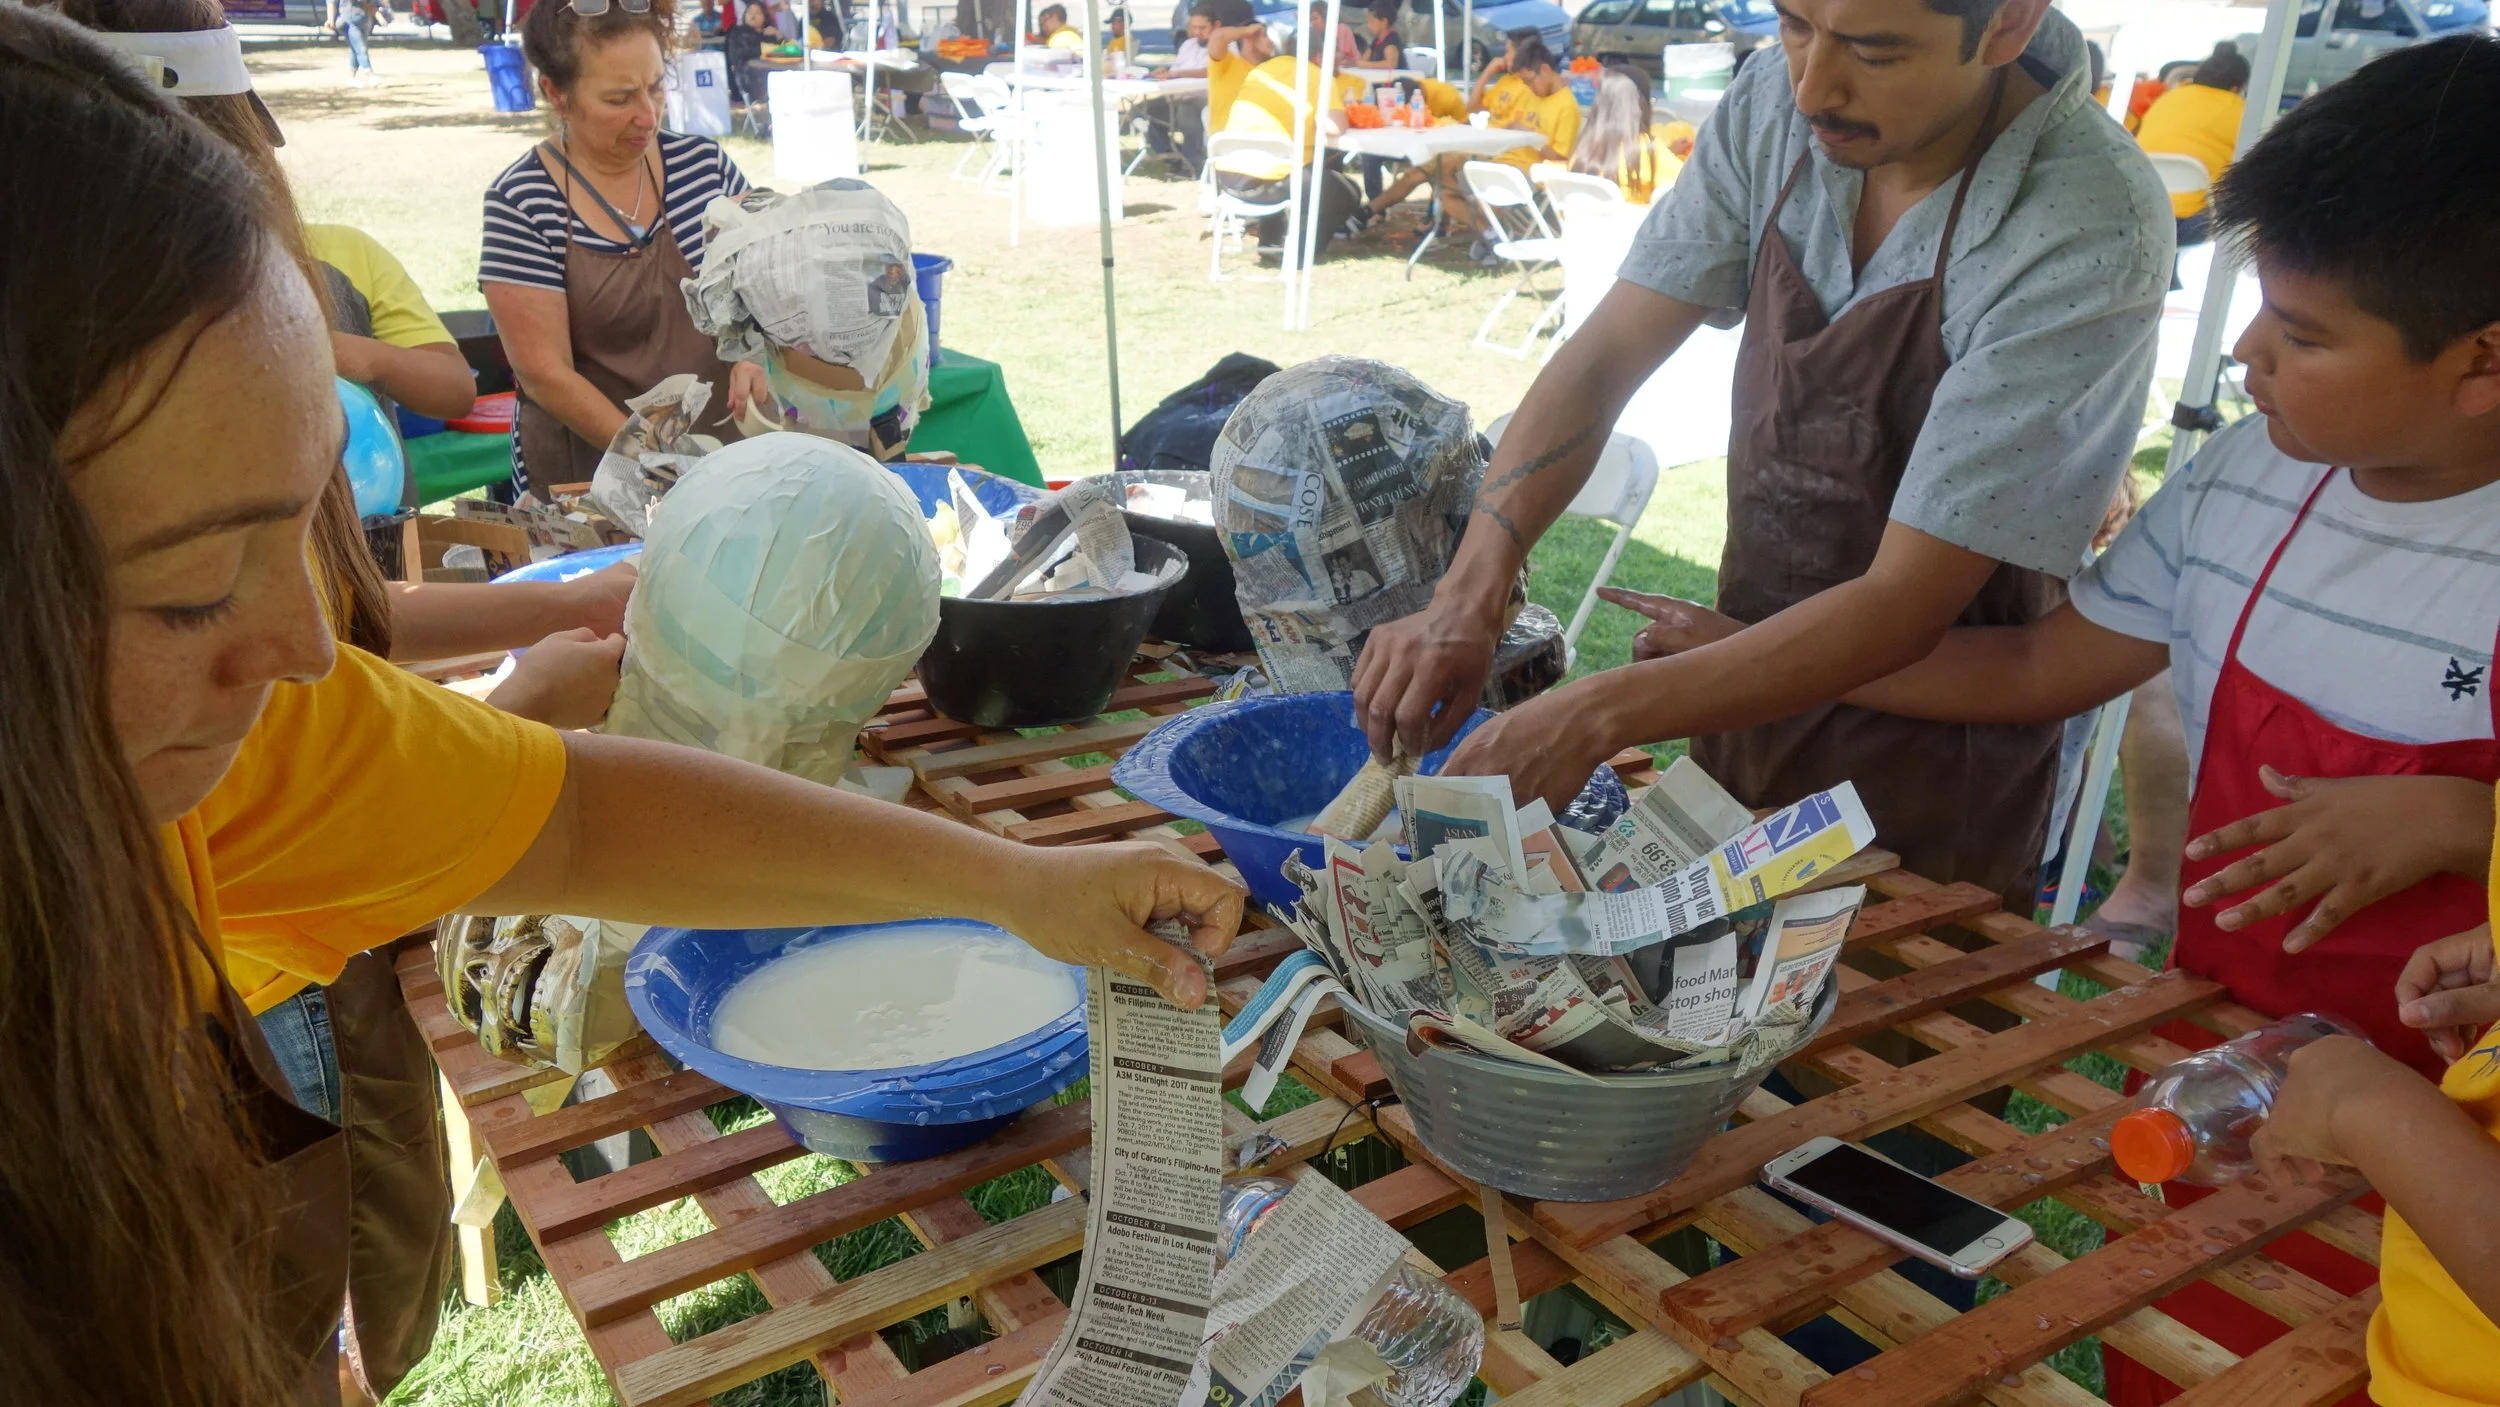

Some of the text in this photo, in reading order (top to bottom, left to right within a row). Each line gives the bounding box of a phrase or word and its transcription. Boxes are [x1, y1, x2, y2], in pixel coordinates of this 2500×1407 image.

[1675, 971, 1706, 990] food
[1114, 995, 1126, 1005] 4th
[1128, 996, 1156, 1009] Filipino
[1119, 1060, 1157, 1071] OCTOBER
[1116, 1070, 1216, 1094] A3M Starnight 2017 annual
[1114, 1147, 1130, 1160] City
[1131, 1150, 1140, 1160] of
[1140, 1152, 1172, 1166] Carson's
[1112, 1214, 1166, 1231] OCTOBER 7-8
[1108, 1225, 1216, 1257] Adobo Festival in Los Angeles
[1100, 1286, 1157, 1306] OCTOBER 9-13
[1093, 1297, 1166, 1322] Glendale Tech Week
[1082, 1340, 1134, 1359] OCTOBER 14
[1094, 1355, 1120, 1370] Annual
[1121, 1362, 1151, 1378] Festival
[1153, 1372, 1162, 1380] of
